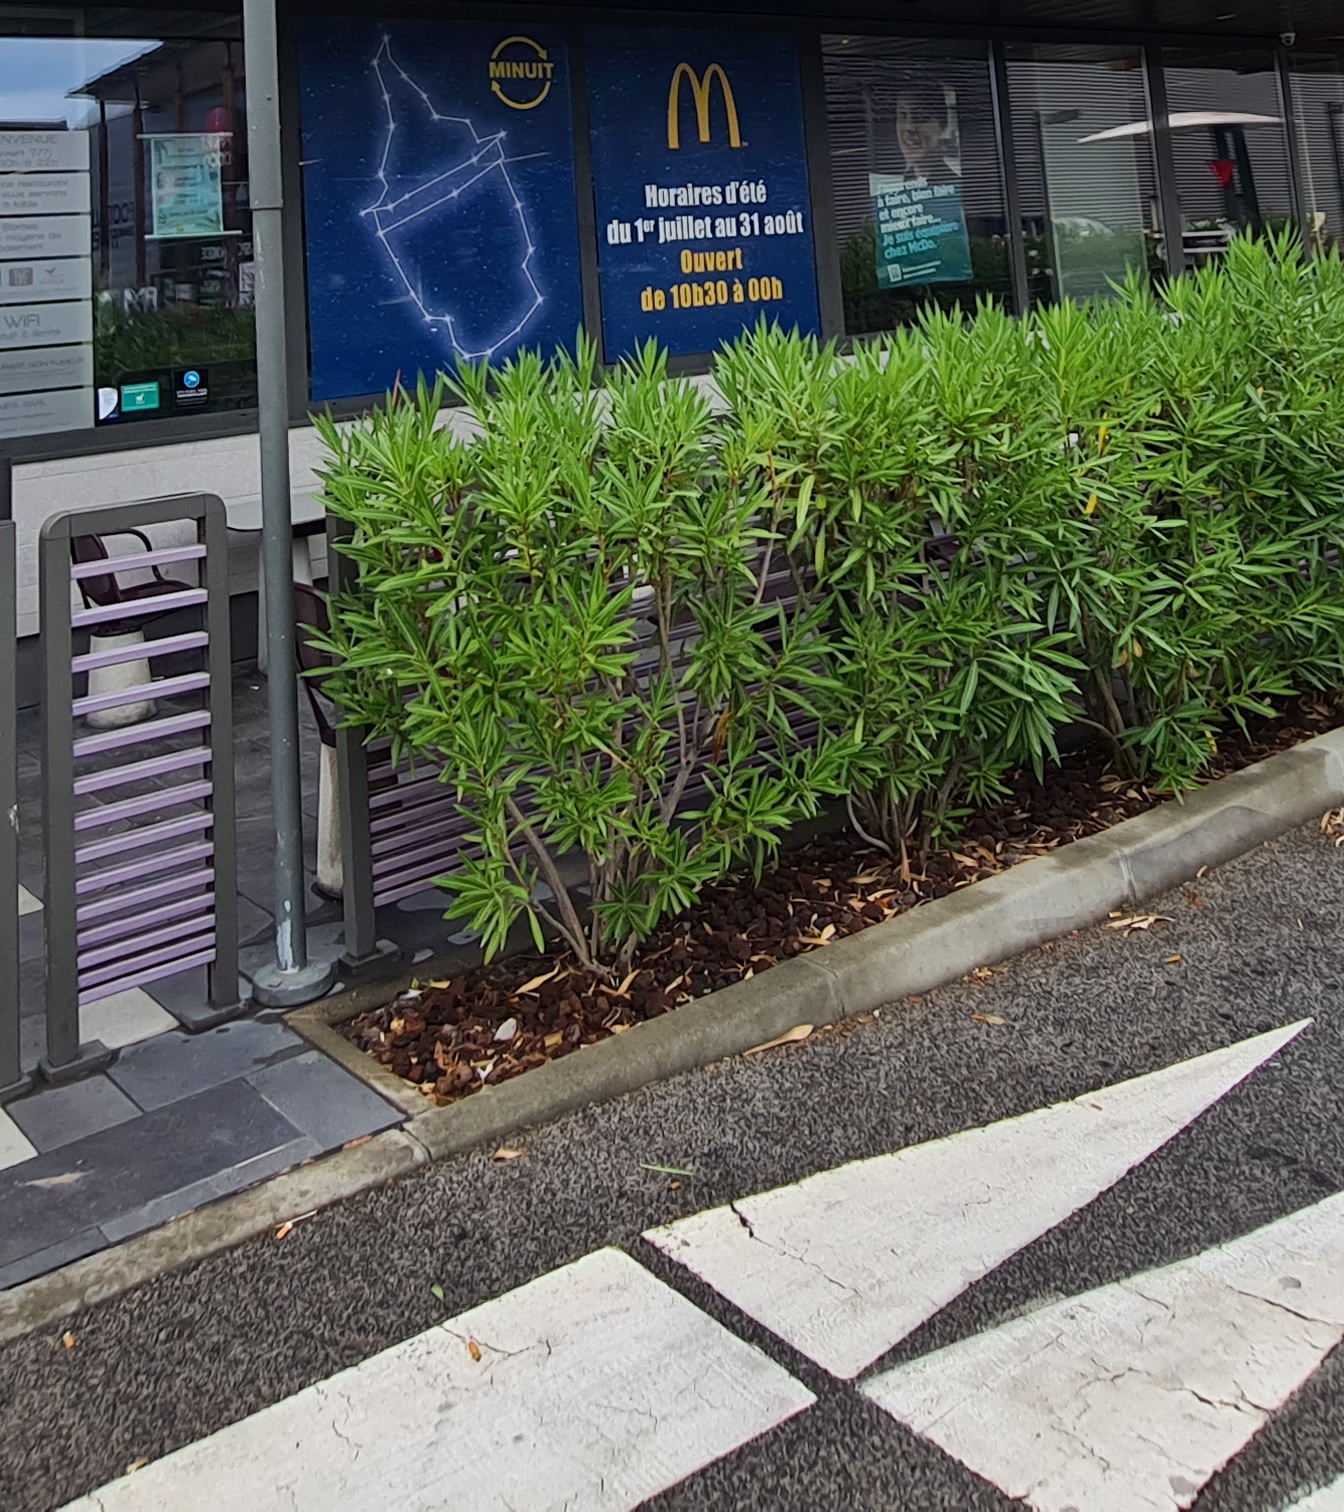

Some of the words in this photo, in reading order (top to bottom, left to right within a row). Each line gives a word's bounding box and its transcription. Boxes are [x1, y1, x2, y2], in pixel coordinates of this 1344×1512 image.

[489, 61, 555, 79] MINUIT
[644, 183, 723, 208] Horaires
[725, 179, 767, 205] d'été
[607, 219, 632, 245] du
[634, 218, 655, 243] 1er
[658, 216, 713, 244] juillet
[715, 217, 737, 238] au
[739, 212, 760, 237] 31
[764, 210, 804, 235] août
[680, 247, 743, 274] Ouvert
[641, 286, 666, 312] de
[670, 279, 728, 309] 10h30
[732, 278, 744, 303] à
[748, 276, 783, 302] 00h
[3, 313, 40, 329] WIFI
